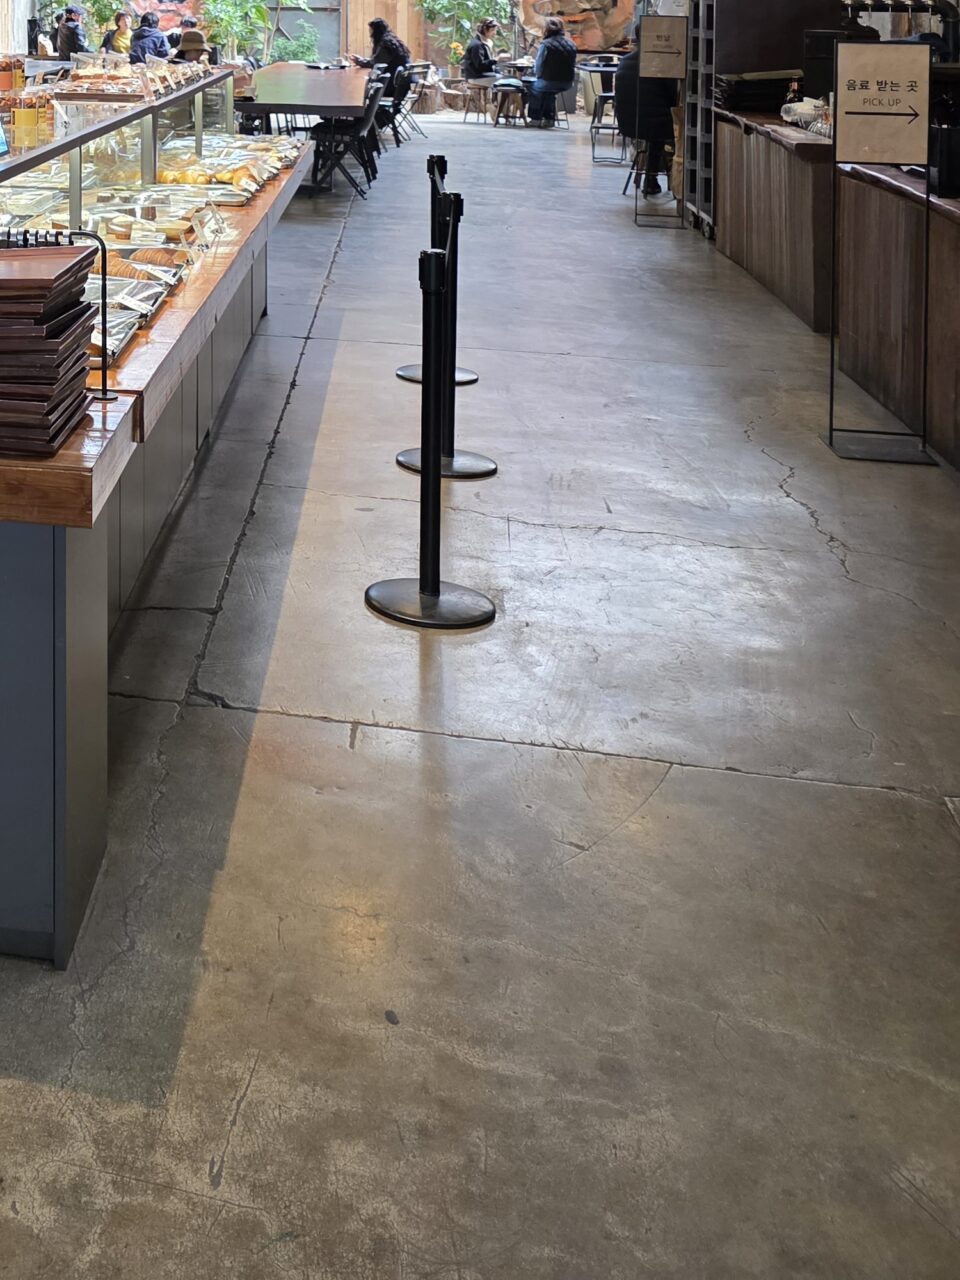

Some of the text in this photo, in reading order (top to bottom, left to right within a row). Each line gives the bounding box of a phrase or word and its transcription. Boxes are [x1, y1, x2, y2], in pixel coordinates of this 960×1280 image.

[845, 79, 920, 93] 음료 받는 곳
[862, 97, 902, 107] PICK UP
